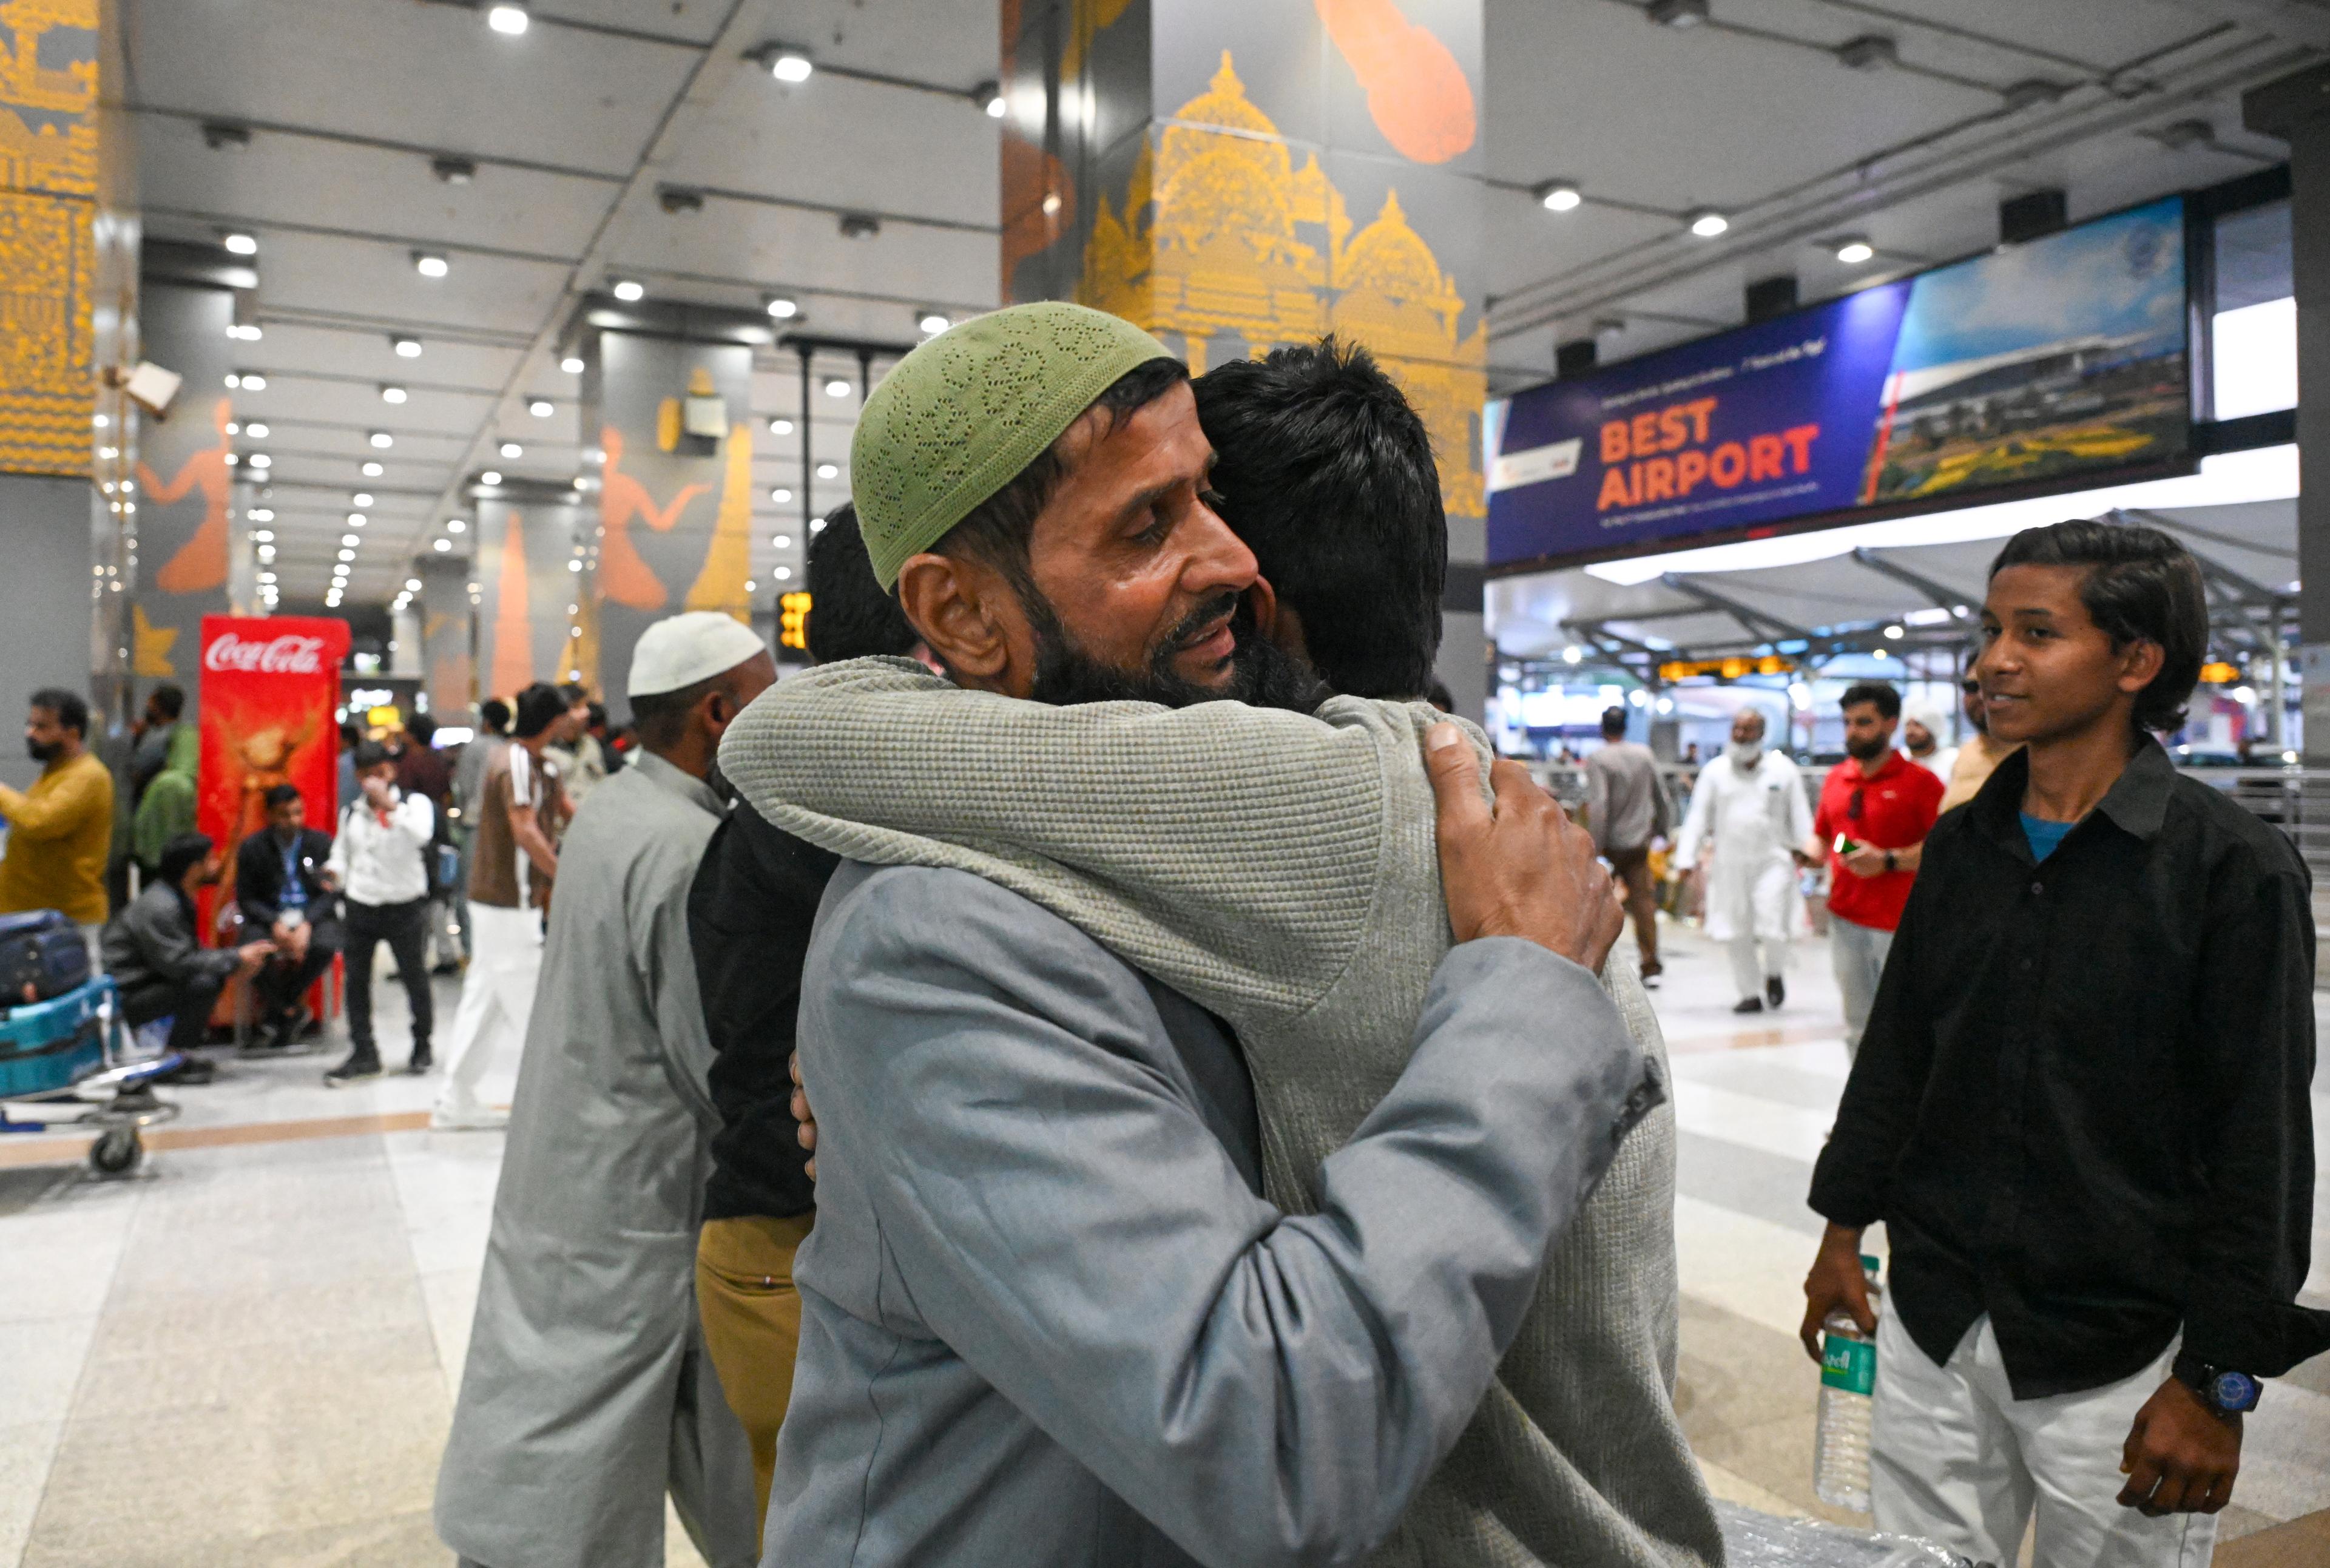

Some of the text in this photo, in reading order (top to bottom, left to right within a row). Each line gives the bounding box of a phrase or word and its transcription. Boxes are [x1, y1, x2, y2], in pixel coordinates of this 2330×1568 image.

[1599, 396, 1718, 464] BEST
[1596, 424, 1820, 511] AIRPORT
[205, 632, 323, 673] Coca-Cola
